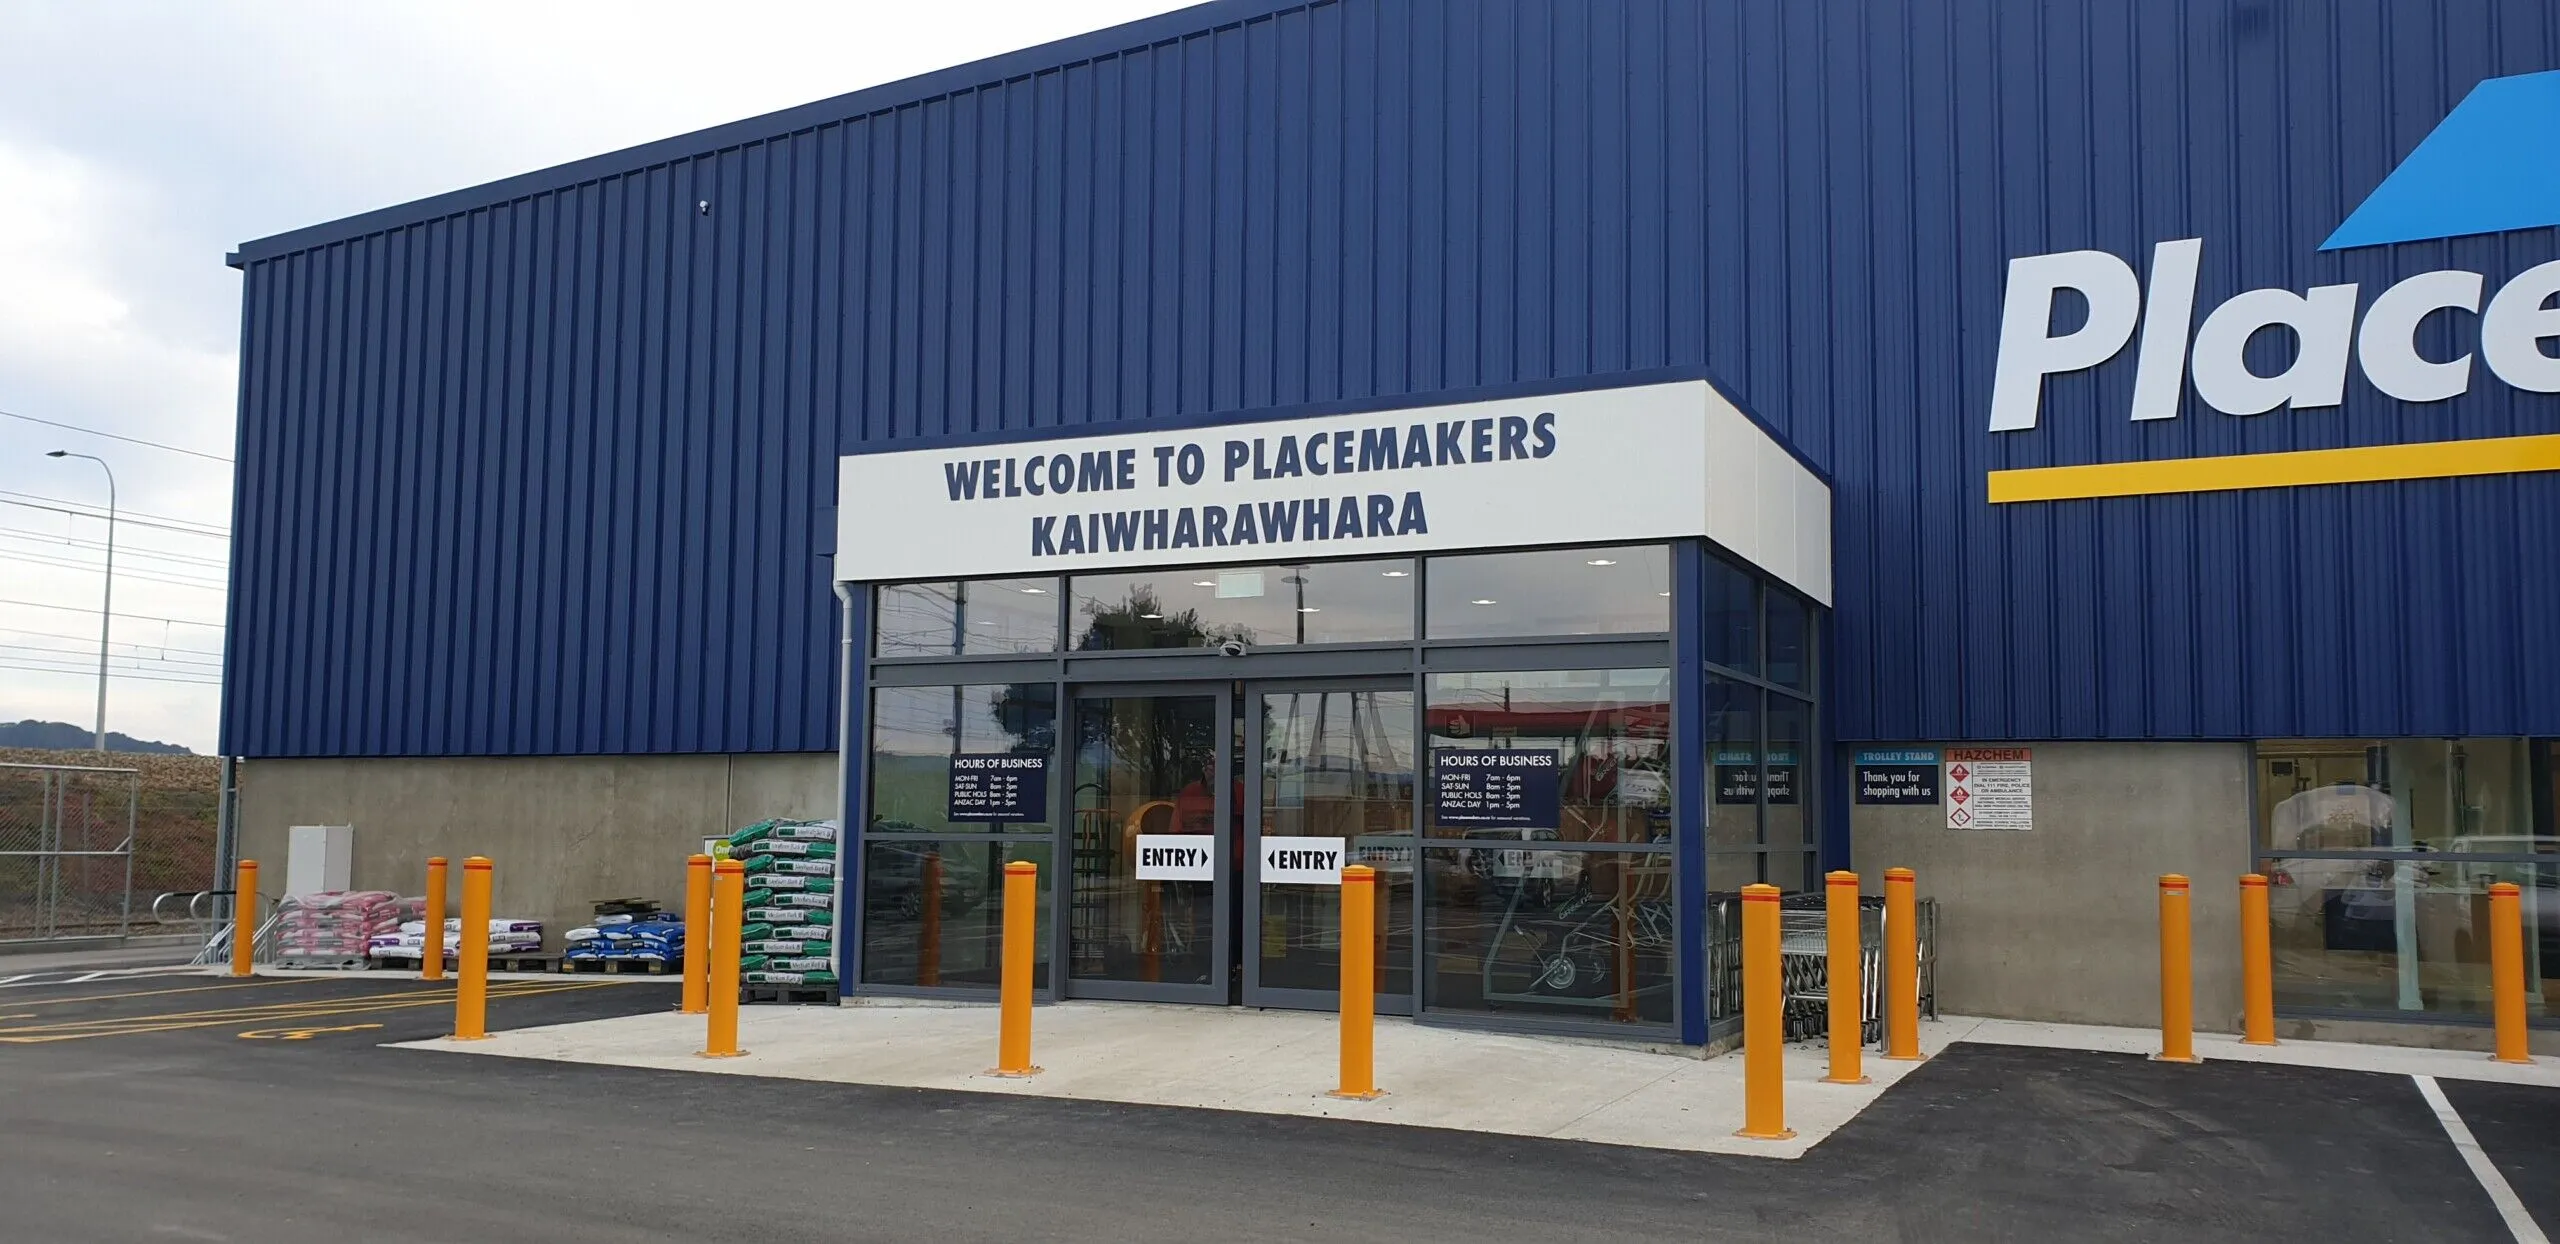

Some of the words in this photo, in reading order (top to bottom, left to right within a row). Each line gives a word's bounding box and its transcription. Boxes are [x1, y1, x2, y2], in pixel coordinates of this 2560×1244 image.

[944, 449, 1135, 501] WELCOME
[1153, 443, 1205, 487] TO
[1224, 412, 1556, 482] PLACEMAKERS
[1032, 491, 1428, 557] KAIWHARAWHARA
[1863, 752, 1901, 760] TROLLEY
[1905, 752, 1934, 760] STAND
[1954, 749, 2024, 760] HAZCHEM
[954, 759, 985, 768] HOURS
[986, 759, 1000, 768] OF
[1001, 758, 1042, 768] BUSINESS
[1441, 756, 1478, 766] HOURS
[1481, 756, 1497, 766] OF
[1500, 756, 1552, 766] BUSINESS
[1506, 774, 1520, 782] 6pm
[1863, 771, 1888, 782] Thank
[1890, 774, 1906, 784] you
[1908, 771, 1920, 782] for
[1506, 783, 1520, 791] 5pm
[1863, 784, 1900, 798] shopping
[1902, 784, 1919, 796] with
[1922, 788, 1931, 796] us
[1506, 792, 1520, 800] 5pm
[1486, 801, 1500, 809] 1pm
[1506, 802, 1520, 810] 5pm
[1142, 848, 1197, 867] ENTRY
[1278, 850, 1337, 870] ENTRY
